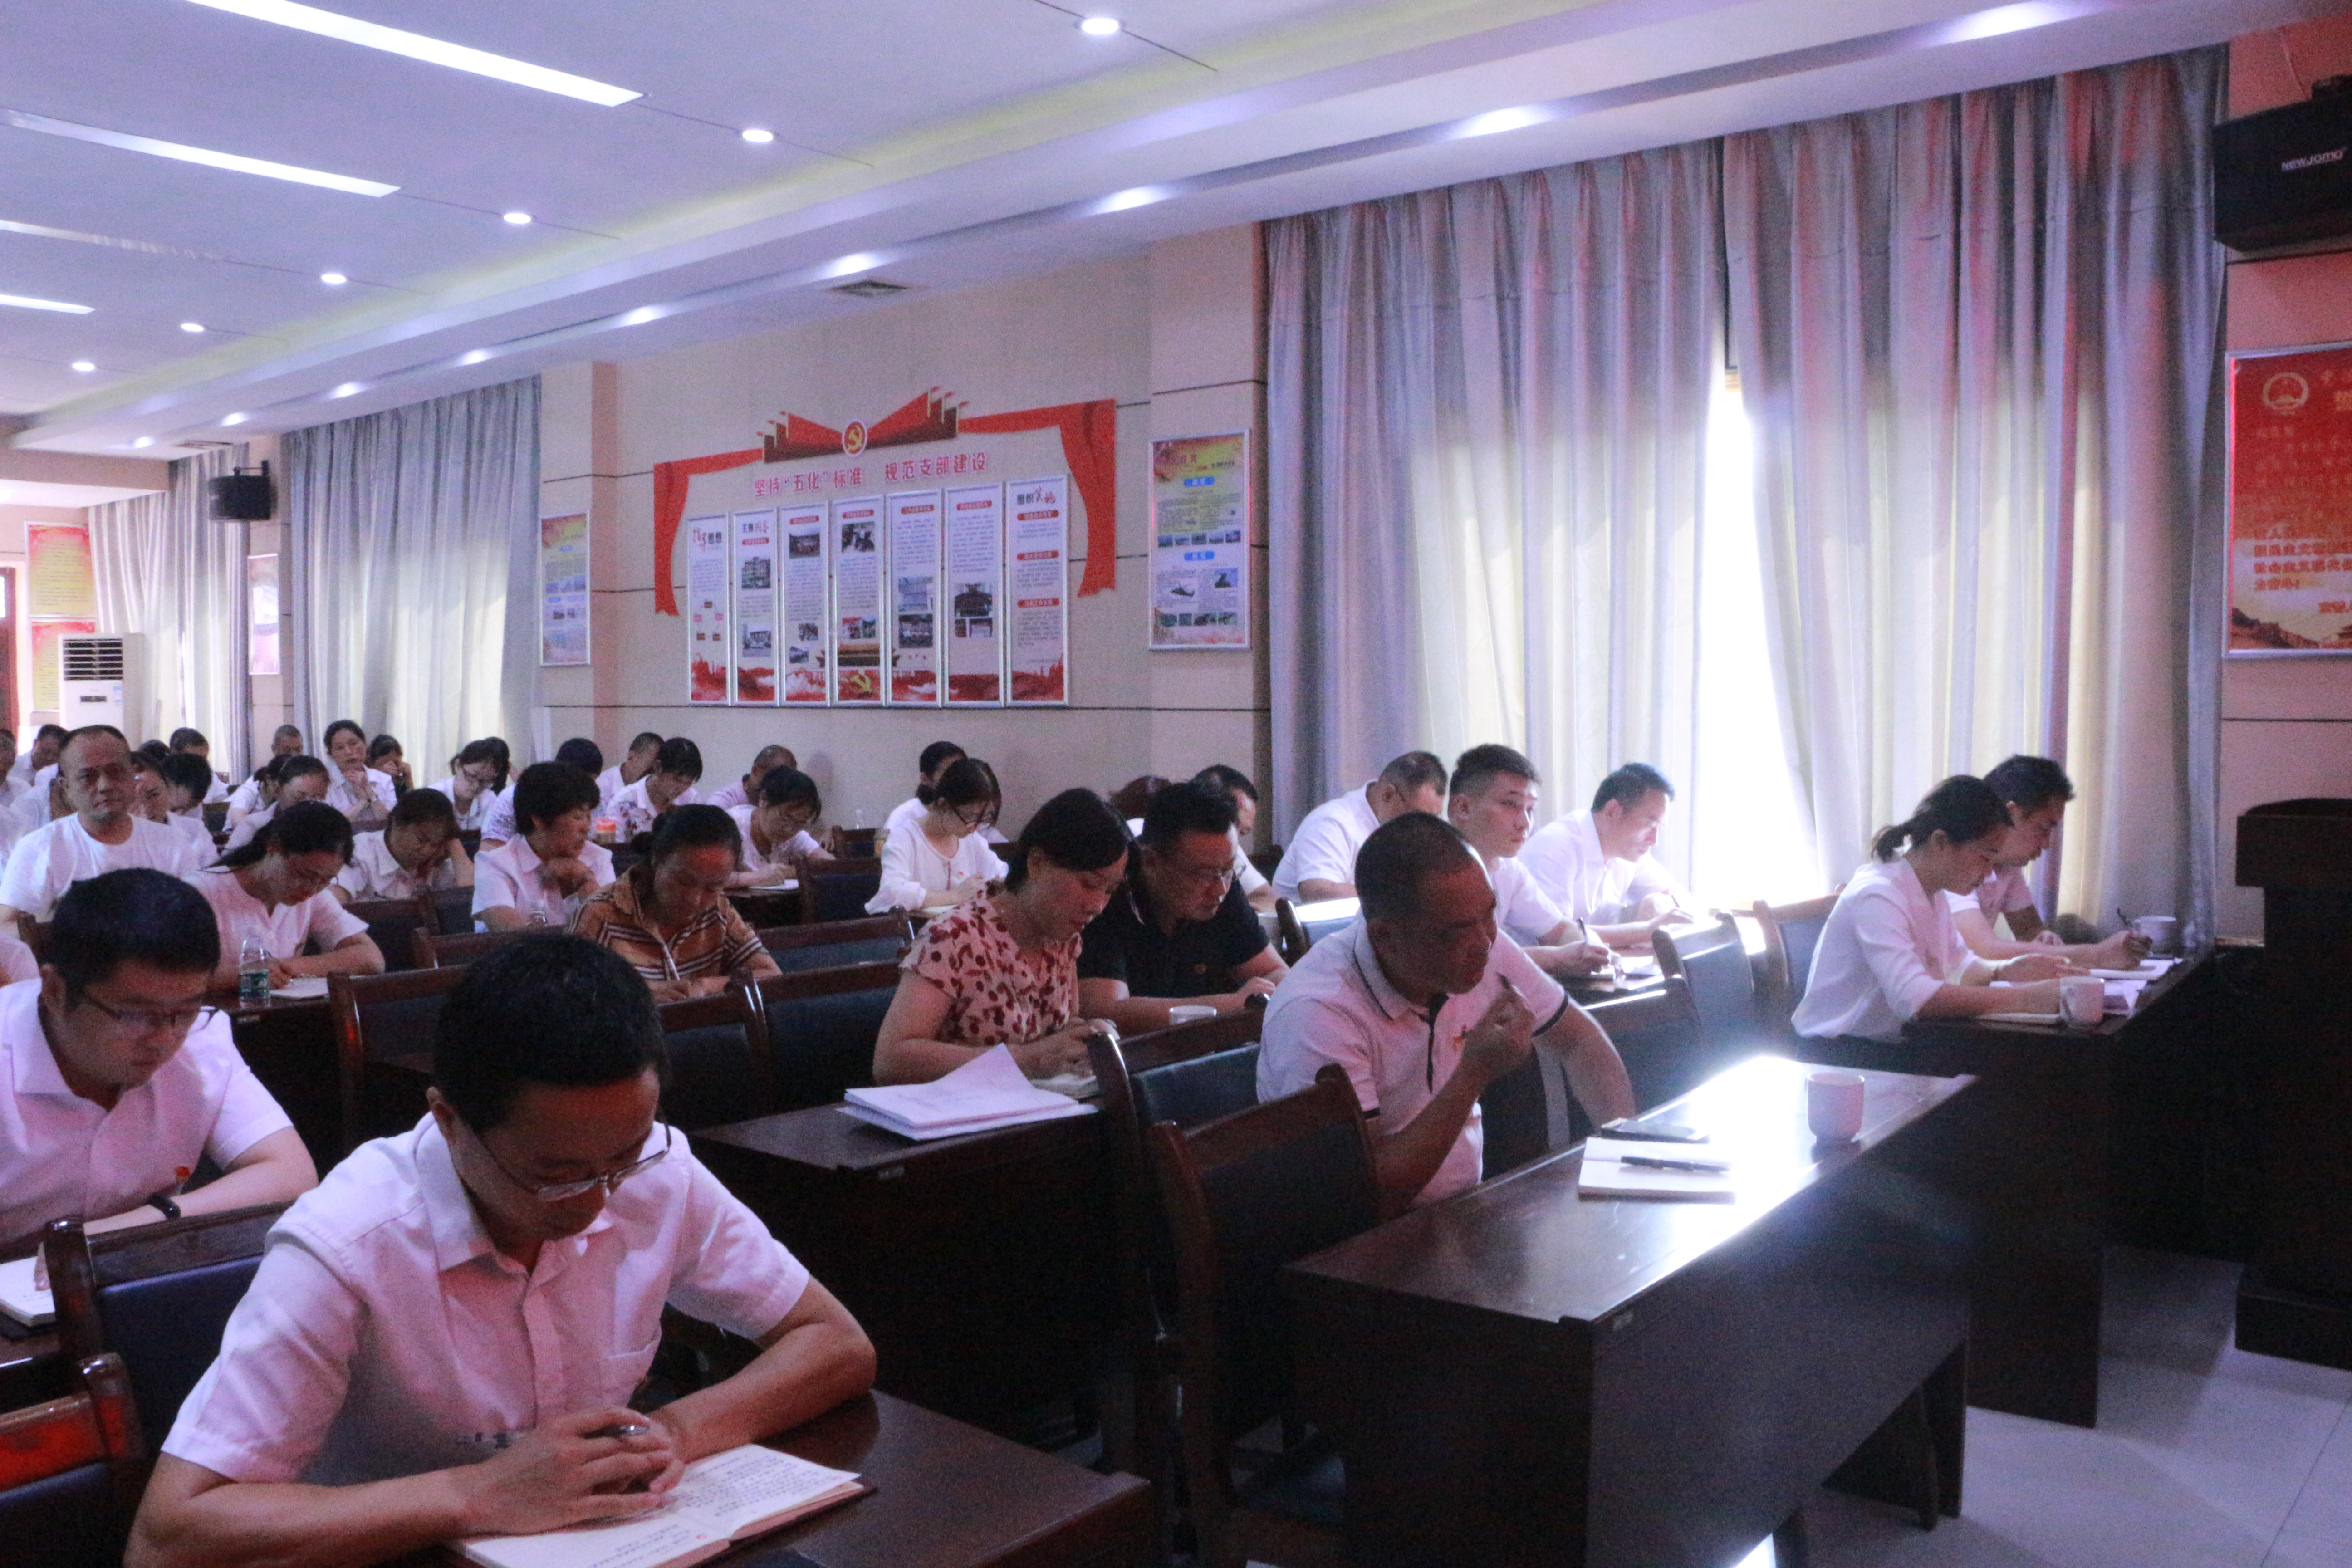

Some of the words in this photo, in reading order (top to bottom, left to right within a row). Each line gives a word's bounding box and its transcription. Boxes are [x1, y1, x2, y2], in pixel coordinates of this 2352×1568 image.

[885, 452, 986, 481] 规范支部建设
